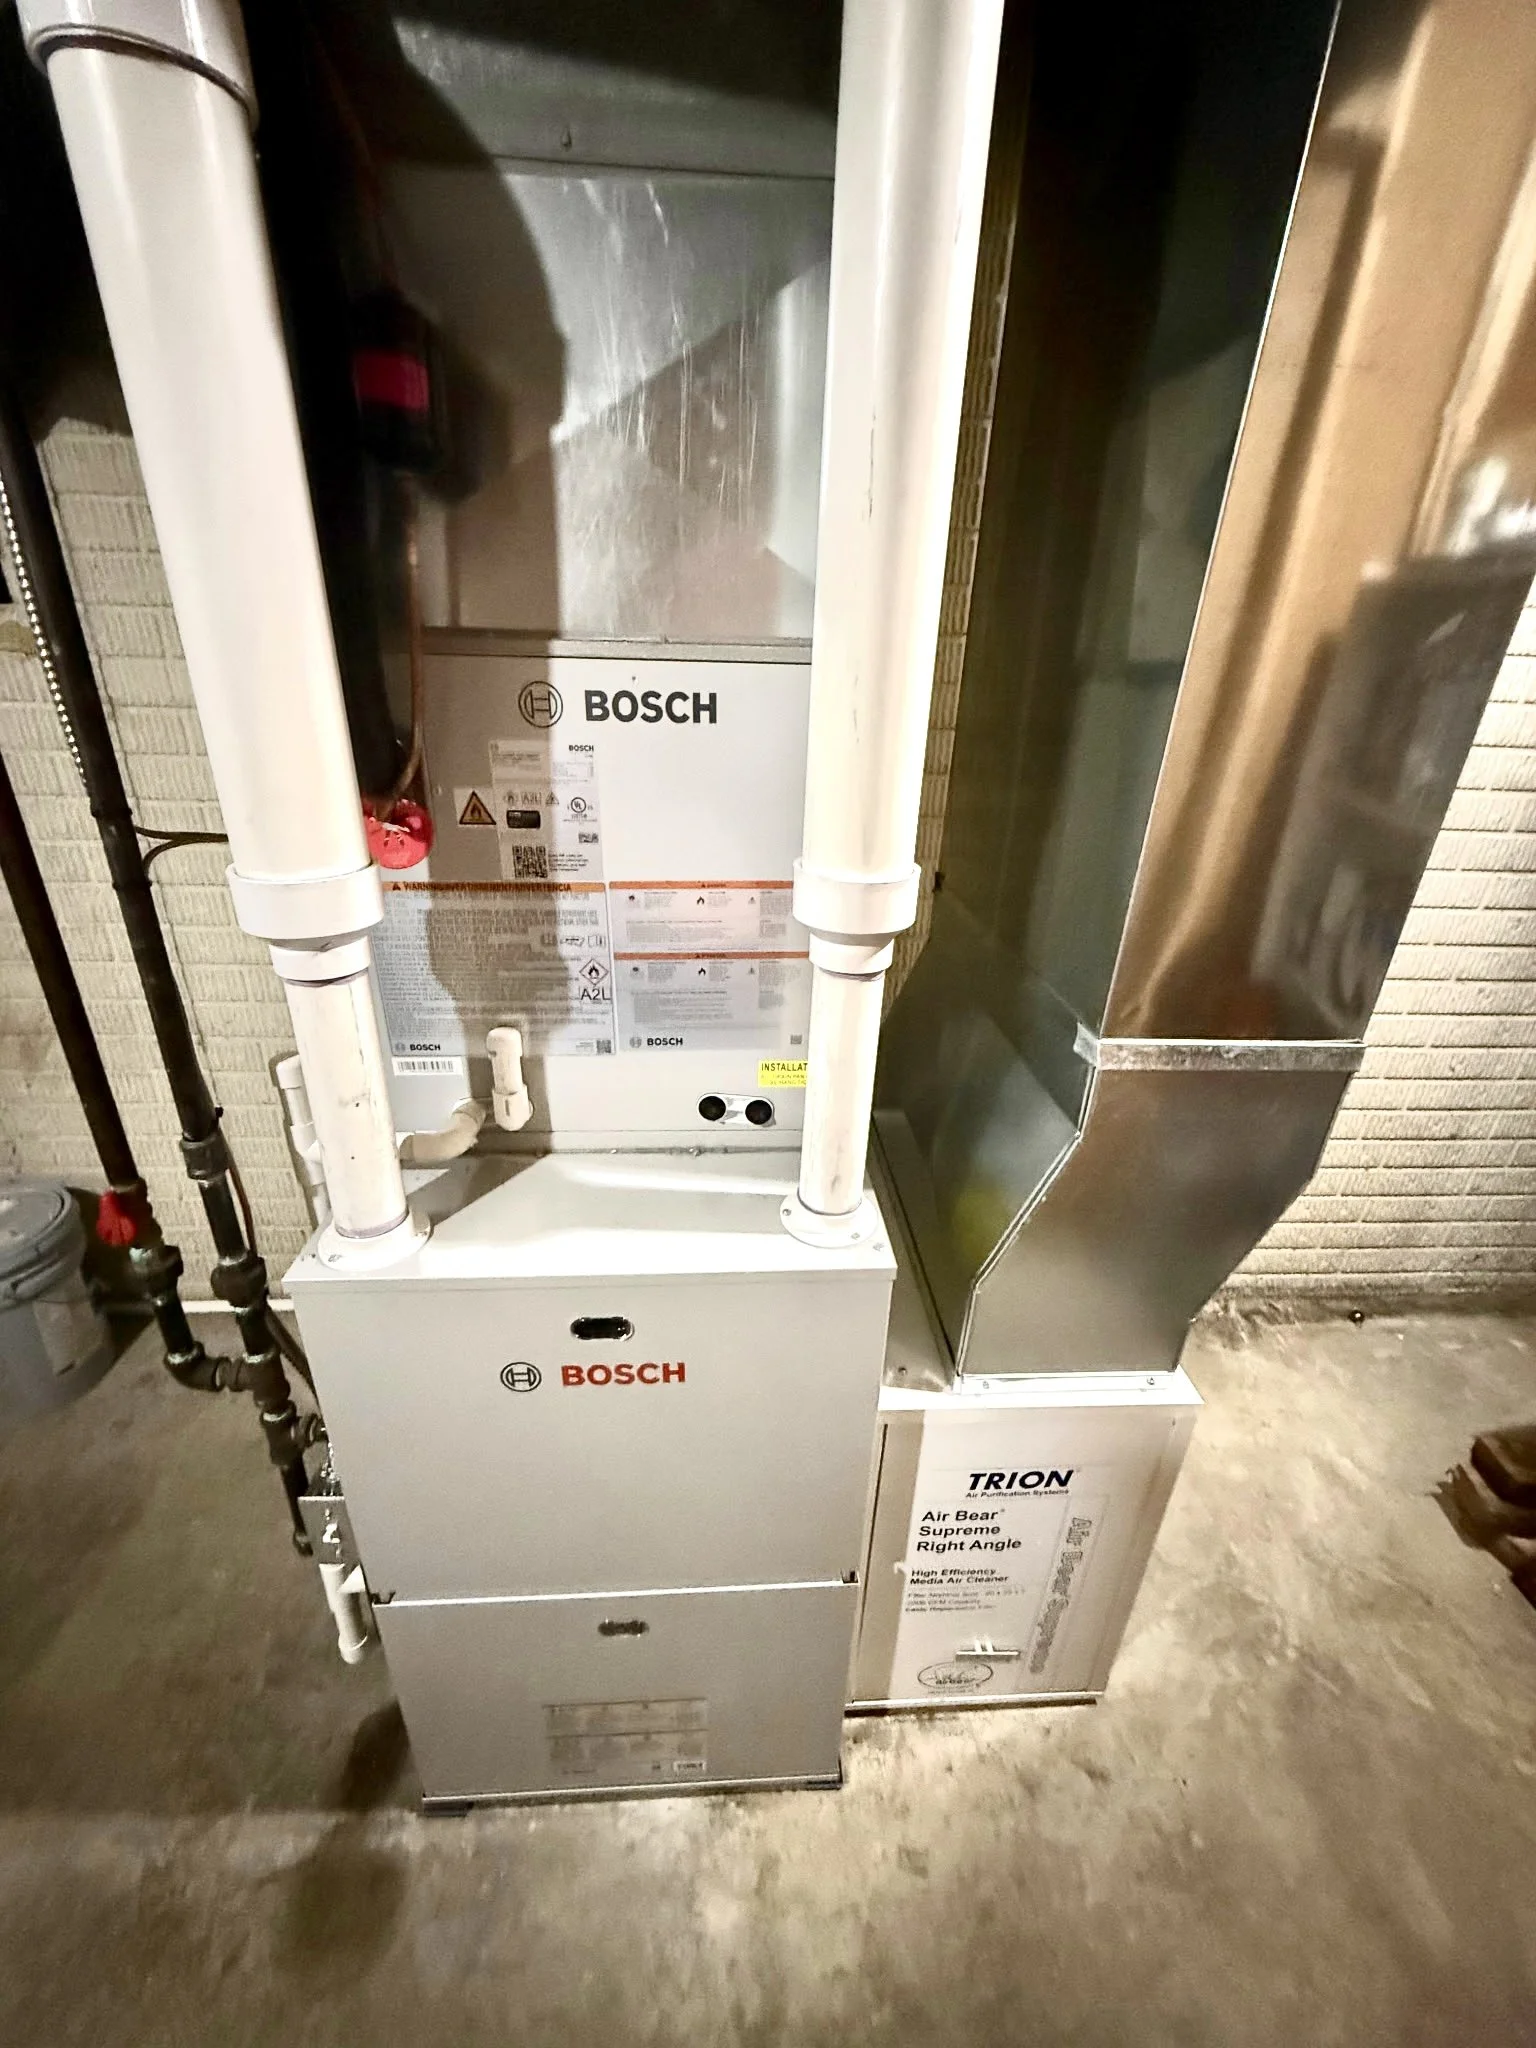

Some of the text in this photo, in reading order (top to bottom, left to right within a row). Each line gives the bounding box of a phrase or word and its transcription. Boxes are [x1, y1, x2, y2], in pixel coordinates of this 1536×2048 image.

[585, 690, 717, 724] BOSCH
[568, 744, 595, 752] BOSCH
[580, 988, 611, 1001] A2L
[646, 1037, 684, 1046] BOSCH
[561, 1362, 686, 1386] BOSCH
[969, 1470, 1074, 1490] TRION
[1032, 1489, 1069, 1497] Systems
[921, 1511, 950, 1522] Air
[919, 1525, 1001, 1538] Supreme
[917, 1538, 1022, 1554] Right Angle
[911, 1568, 997, 1578] High Efficiency
[910, 1577, 944, 1585] Media
[966, 1575, 1009, 1583] Cleaner
